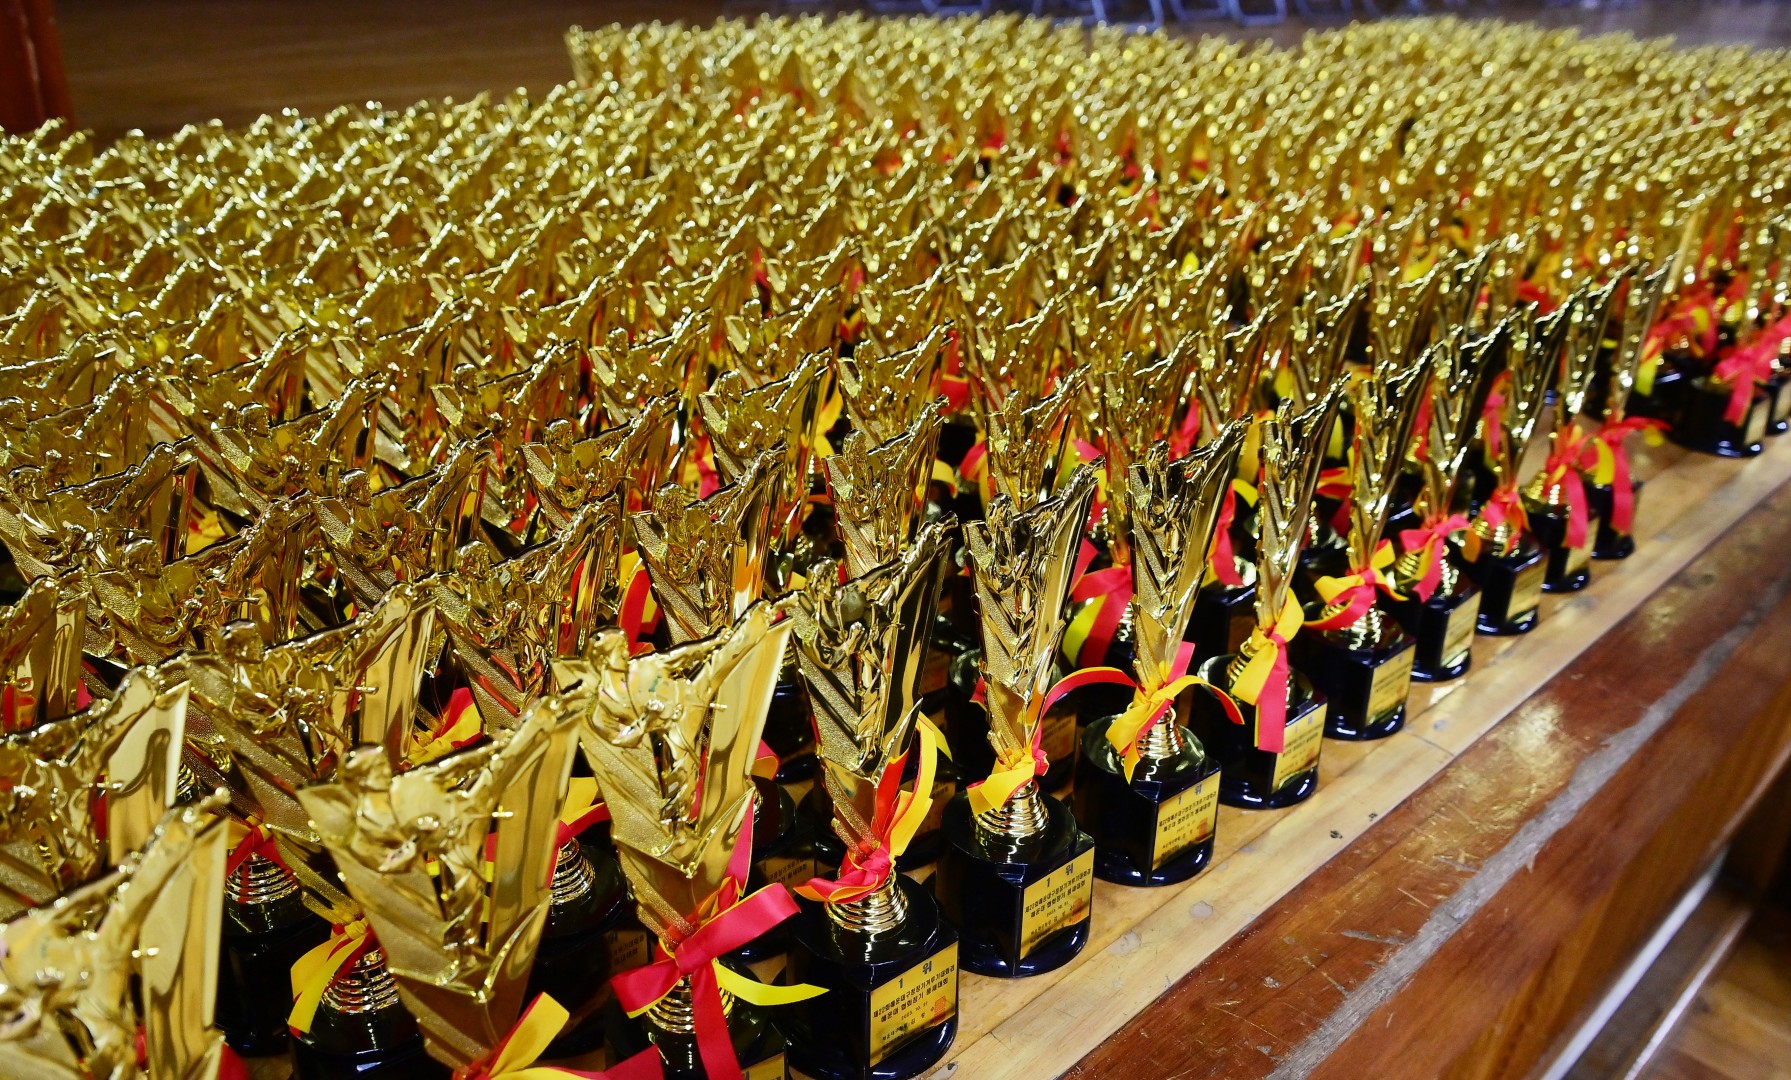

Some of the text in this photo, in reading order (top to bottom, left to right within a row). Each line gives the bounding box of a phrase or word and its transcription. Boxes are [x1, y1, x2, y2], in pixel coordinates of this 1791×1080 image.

[1046, 863, 1074, 887] 1 위
[898, 961, 932, 989] 1 위
